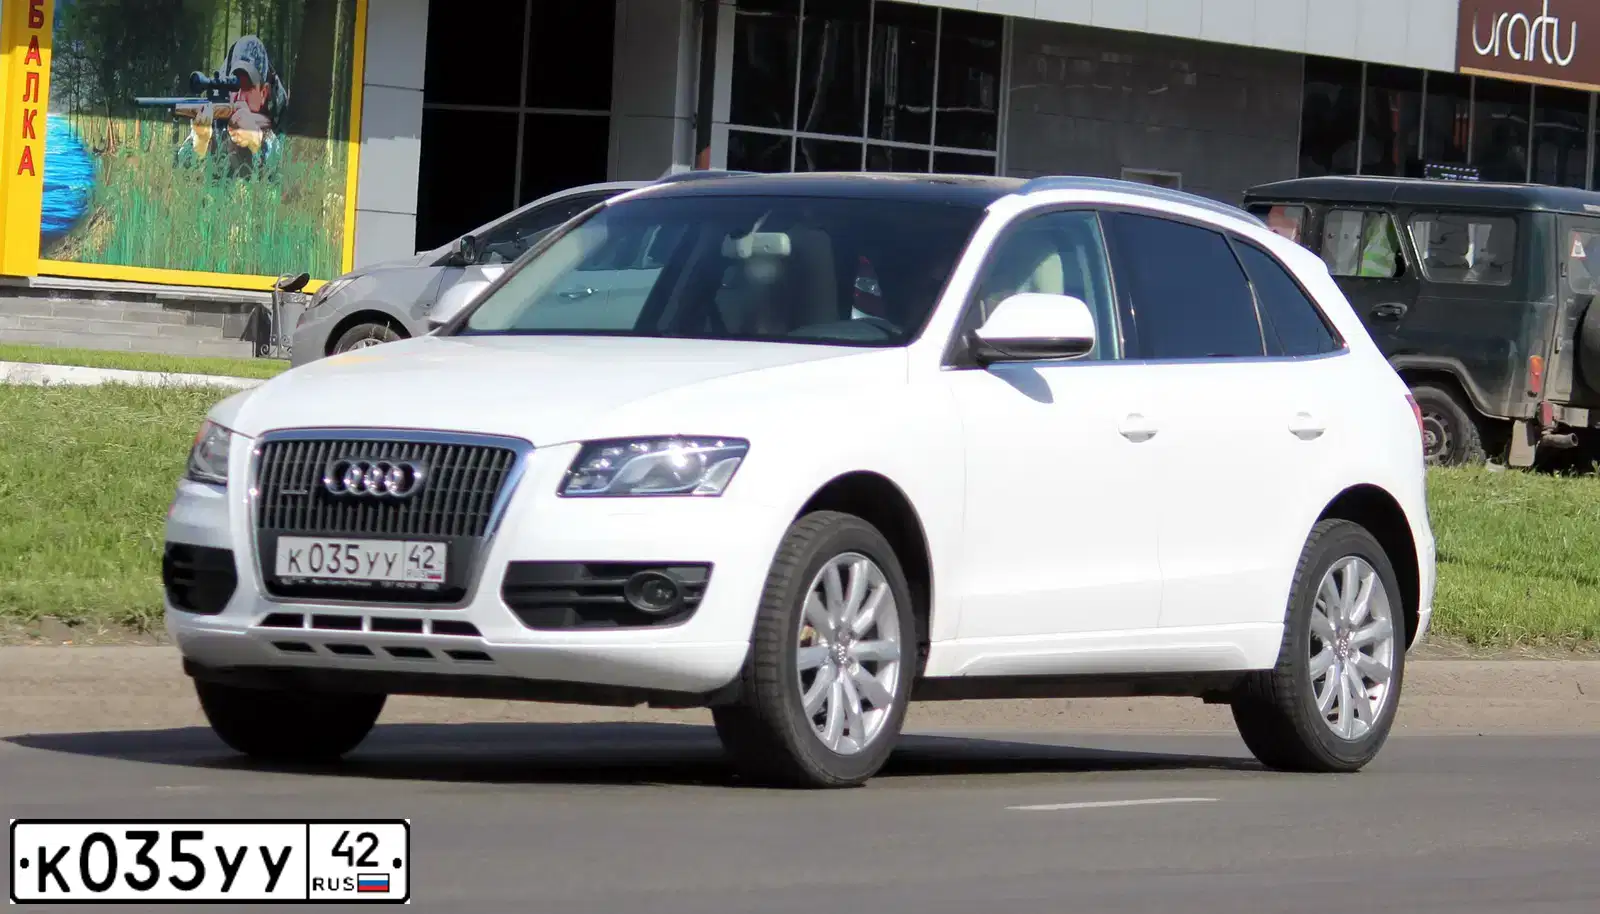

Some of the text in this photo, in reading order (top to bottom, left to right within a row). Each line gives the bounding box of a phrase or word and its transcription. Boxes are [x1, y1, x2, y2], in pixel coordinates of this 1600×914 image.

[1472, 0, 1577, 66] urartu
[17, 0, 44, 177] БАЛКА
[409, 544, 435, 569] 42
